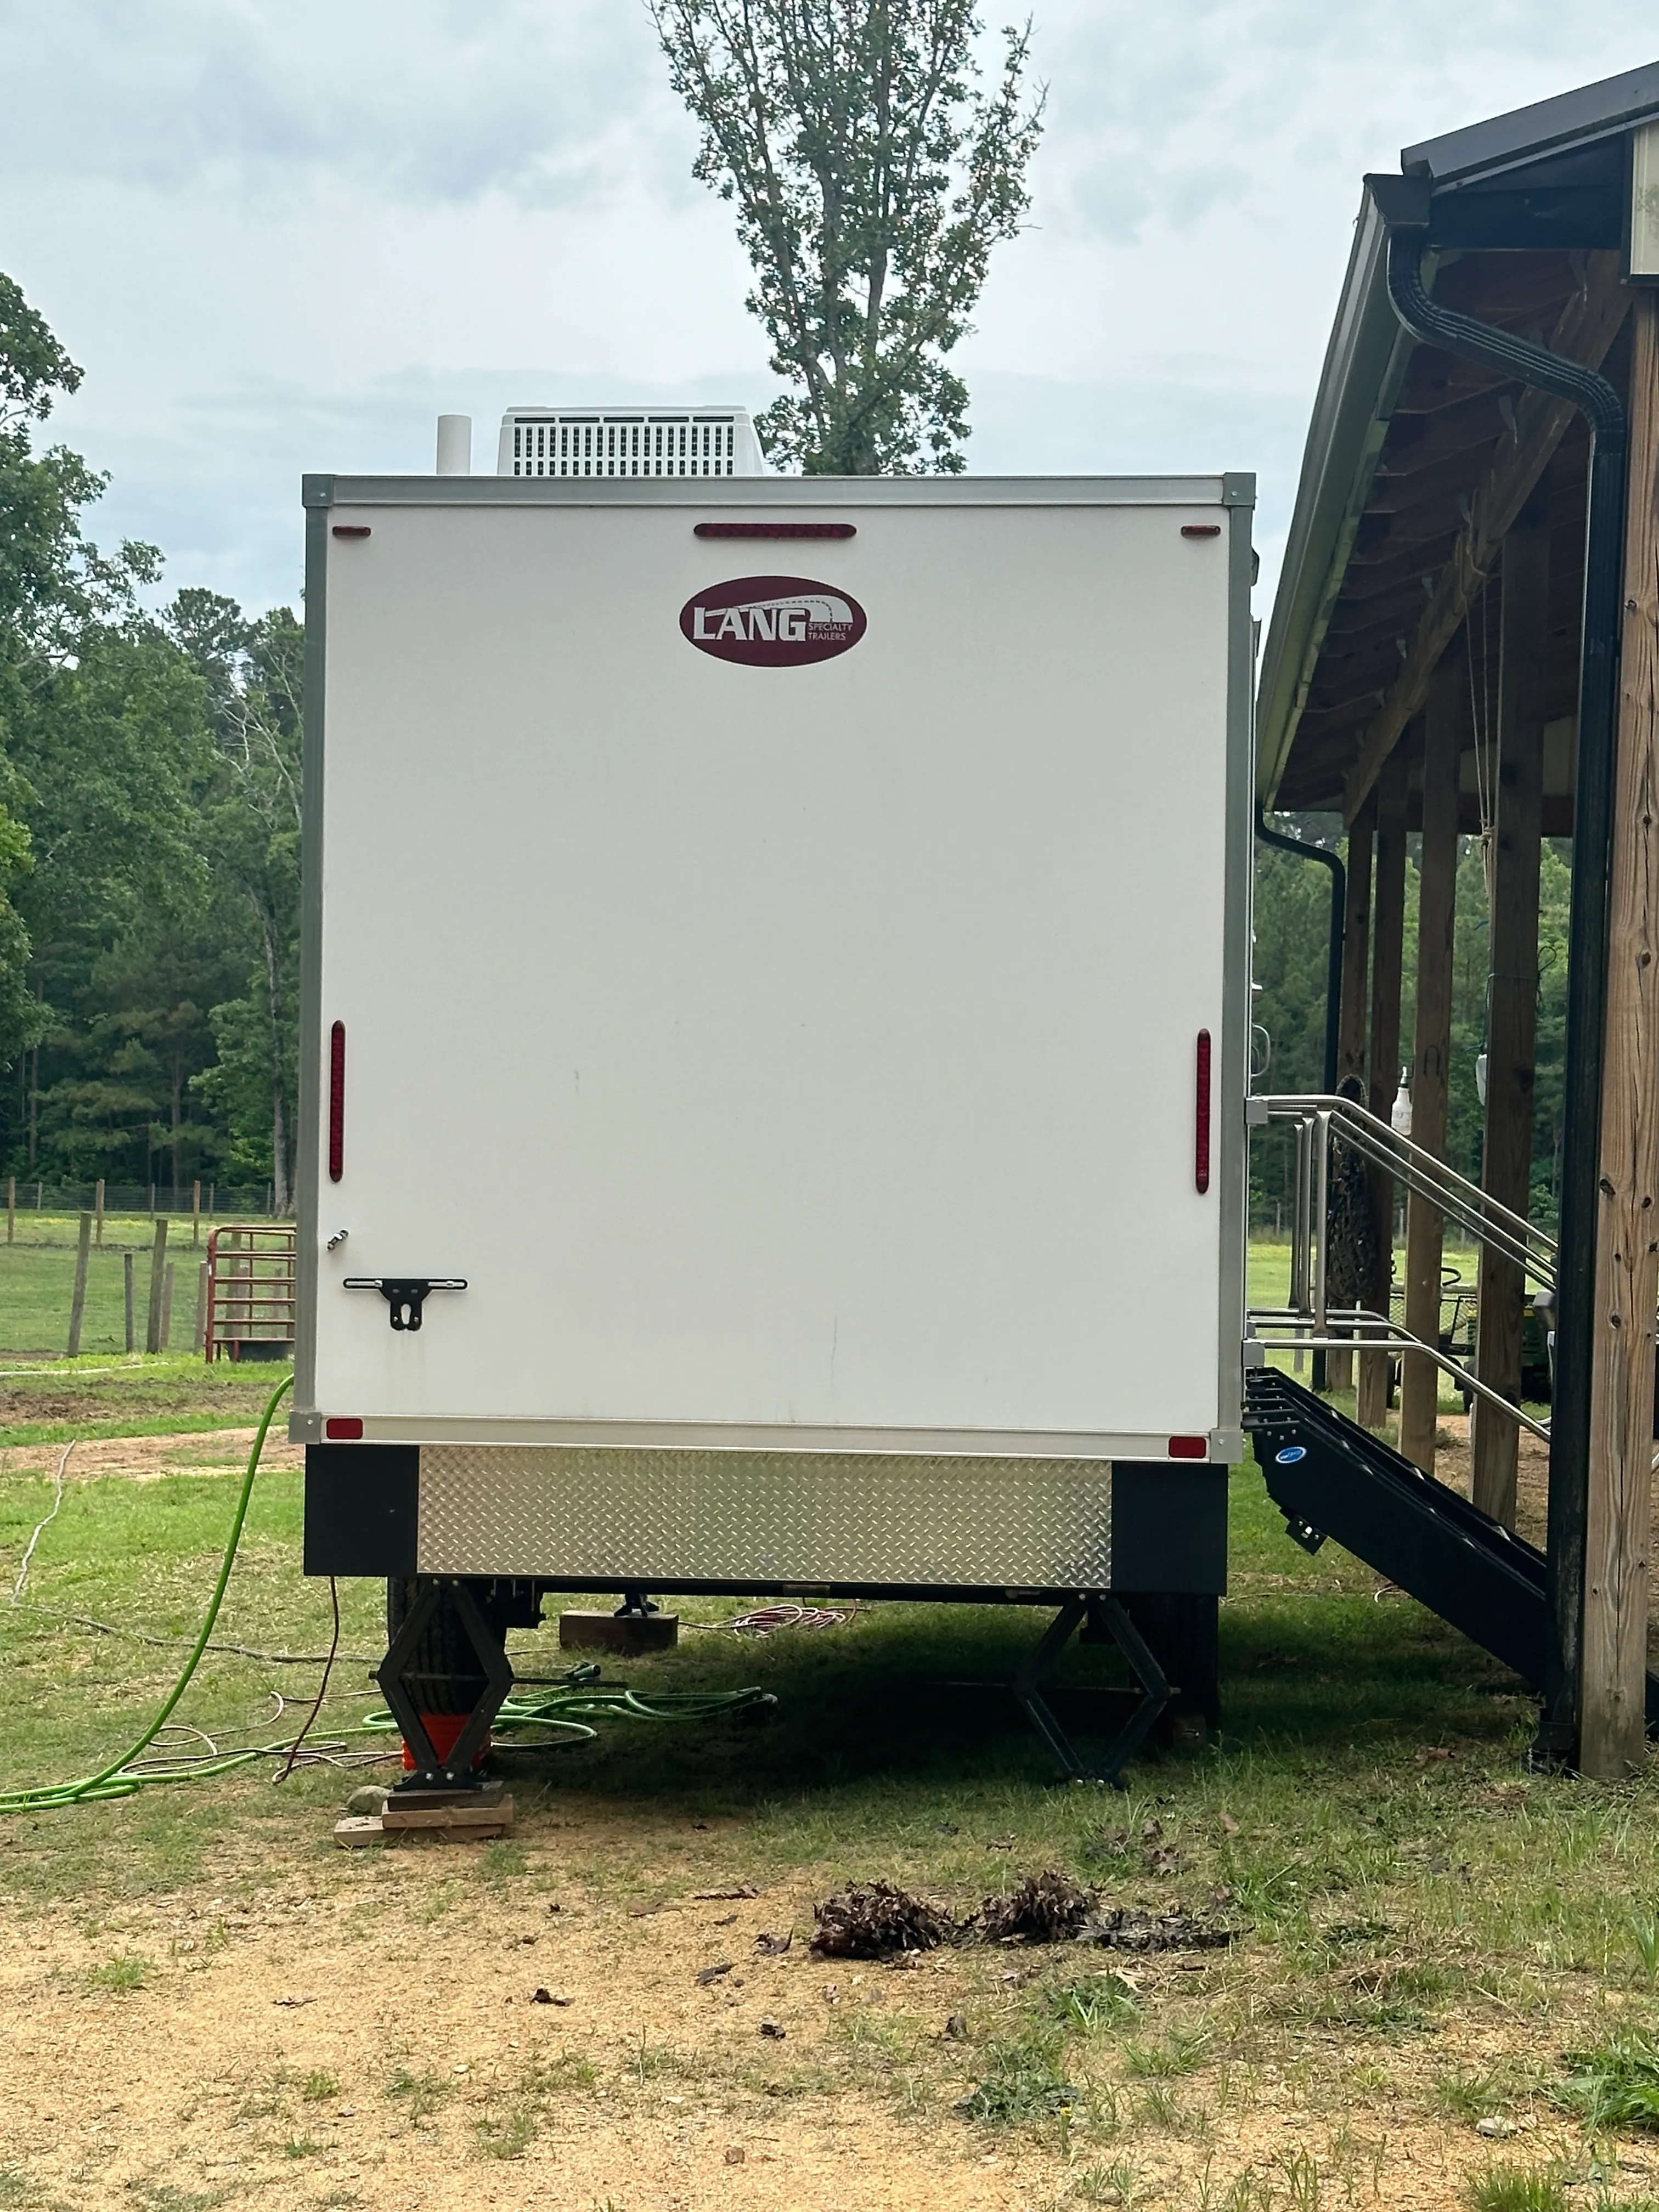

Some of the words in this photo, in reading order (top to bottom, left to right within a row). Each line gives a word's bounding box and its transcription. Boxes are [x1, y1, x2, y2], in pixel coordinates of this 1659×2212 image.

[693, 607, 806, 641] LANG
[808, 623, 853, 631] SPECIALTY
[808, 632, 847, 641] TRAILERS
